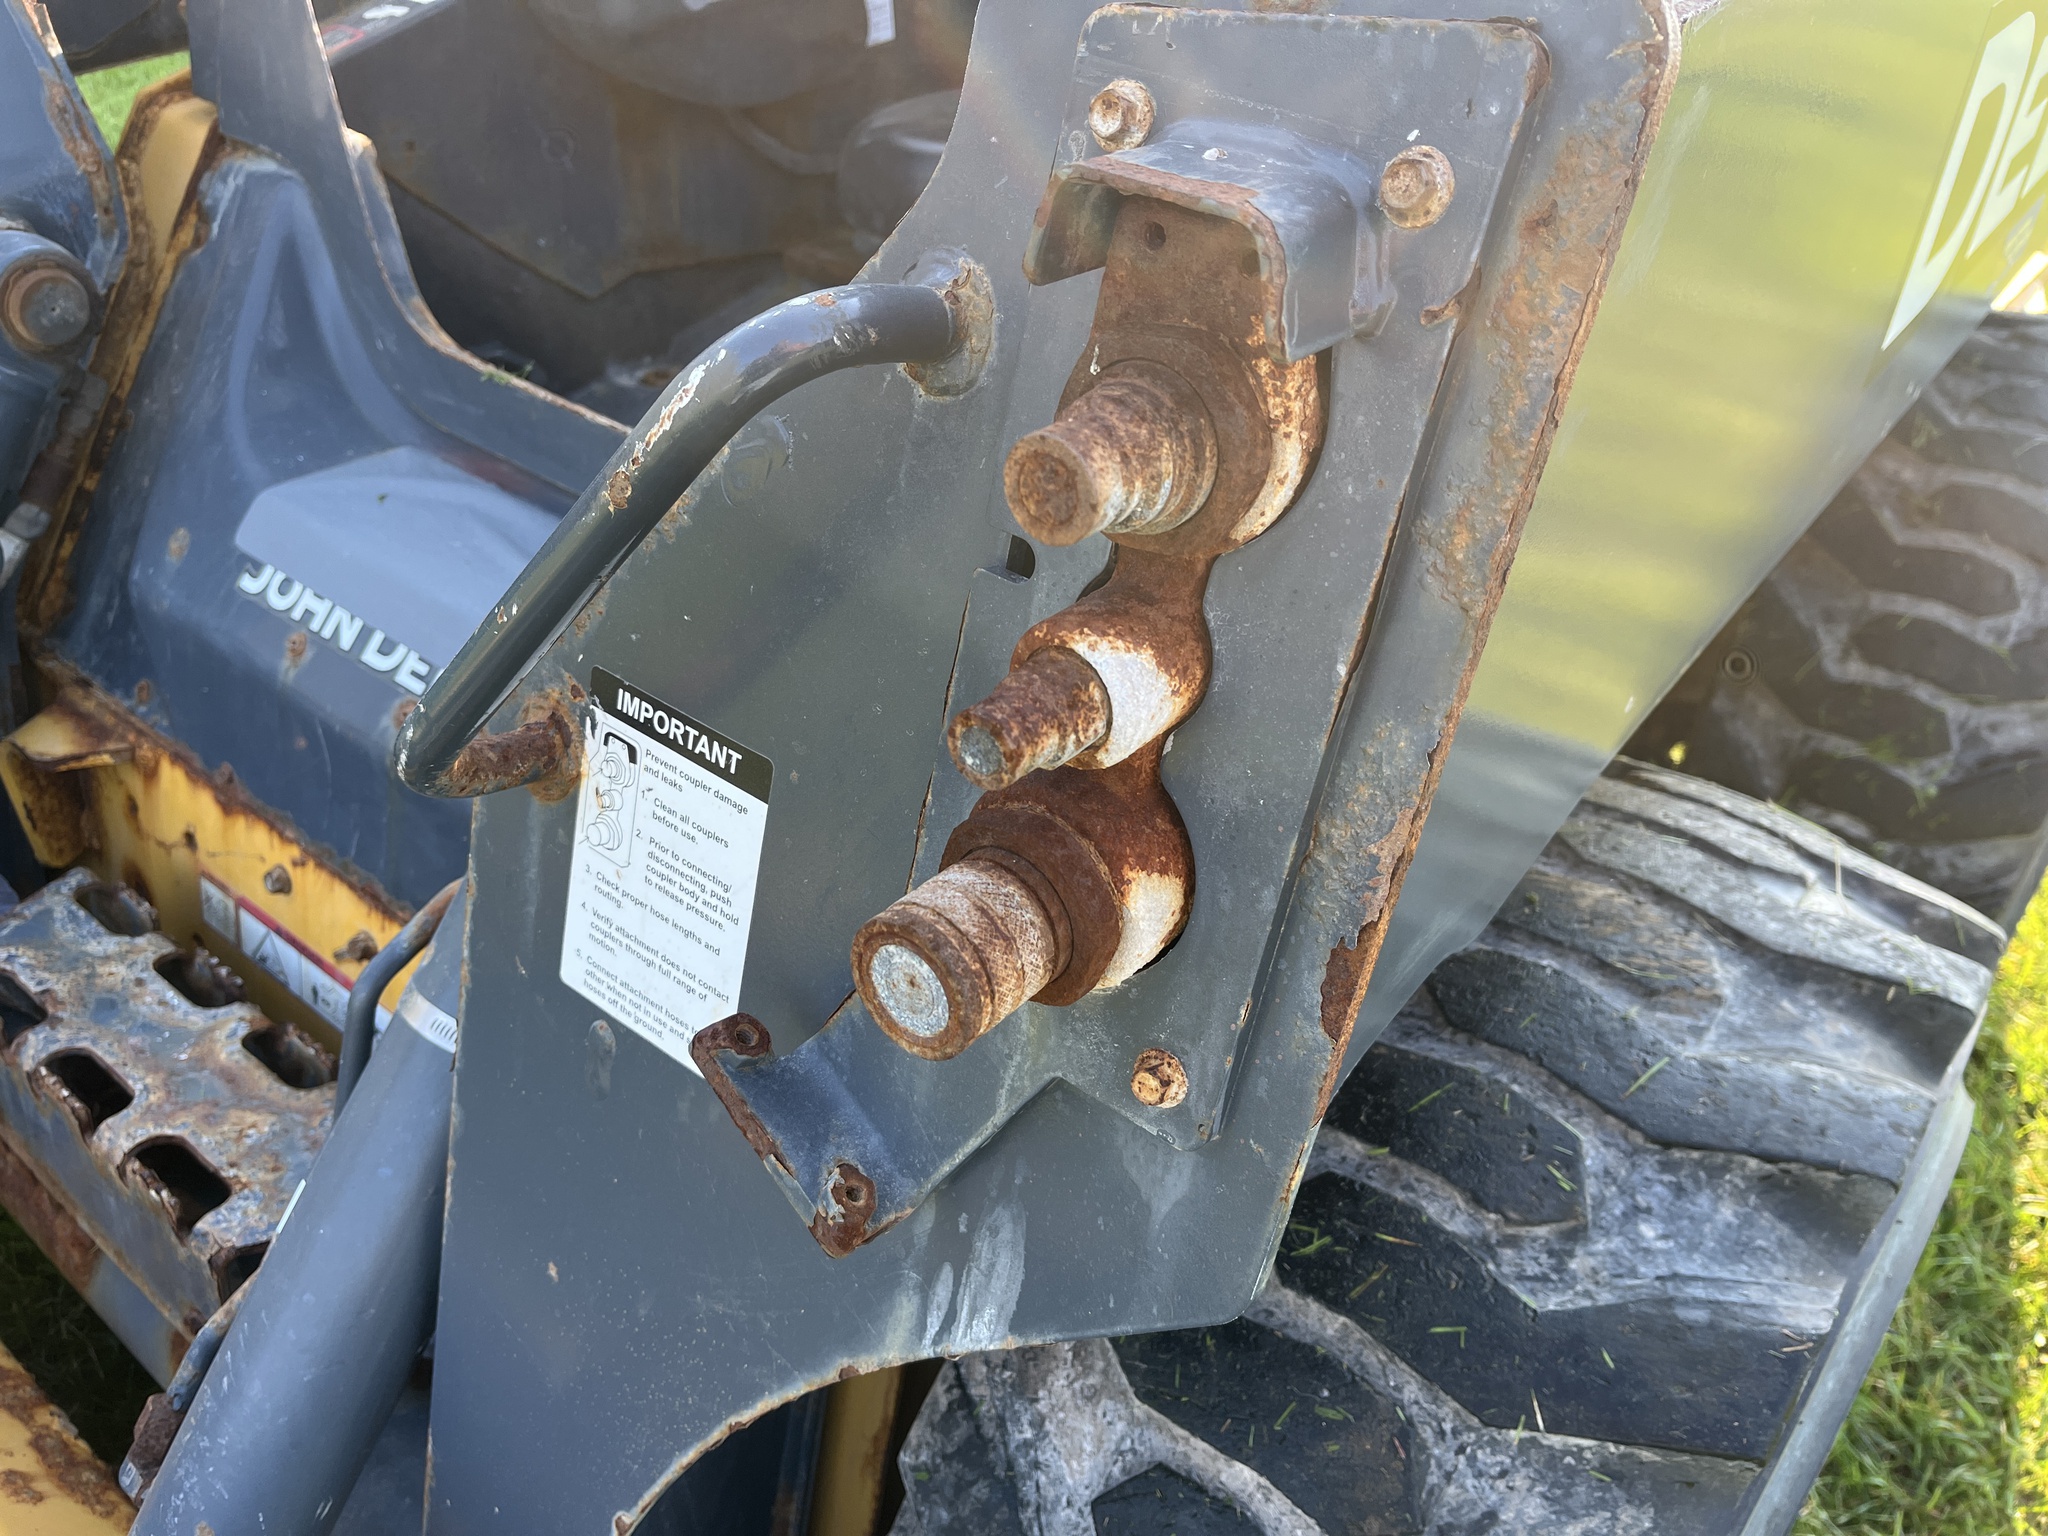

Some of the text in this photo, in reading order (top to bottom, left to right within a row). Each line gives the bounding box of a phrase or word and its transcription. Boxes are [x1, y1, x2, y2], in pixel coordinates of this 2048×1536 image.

[237, 562, 445, 697] JOHN DE
[616, 687, 743, 775] IMPORTANT
[643, 764, 683, 793] and leaks
[645, 748, 749, 815] Prevent coupler damage
[641, 790, 729, 849] 1. Clean all couplers
[652, 810, 698, 845] before use.
[635, 828, 733, 894] 2. Prior to connecting/
[647, 850, 732, 908] disconnecting, push
[585, 864, 721, 957] 3. Check proper hose lengths and
[594, 884, 624, 909] routing.
[644, 875, 726, 932] to release pressure.
[646, 863, 740, 926] coupler body and hold
[581, 901, 730, 1004] 4. Verify attachment does not contact
[588, 932, 618, 957] motion.
[590, 921, 708, 1002] couplers through full range of
[583, 978, 665, 1041] hoses off the ground.
[585, 968, 685, 1040] other when not in use and
[586, 955, 619, 982] Connect
[619, 979, 663, 1013] attachment
[665, 1008, 690, 1031] hoses
